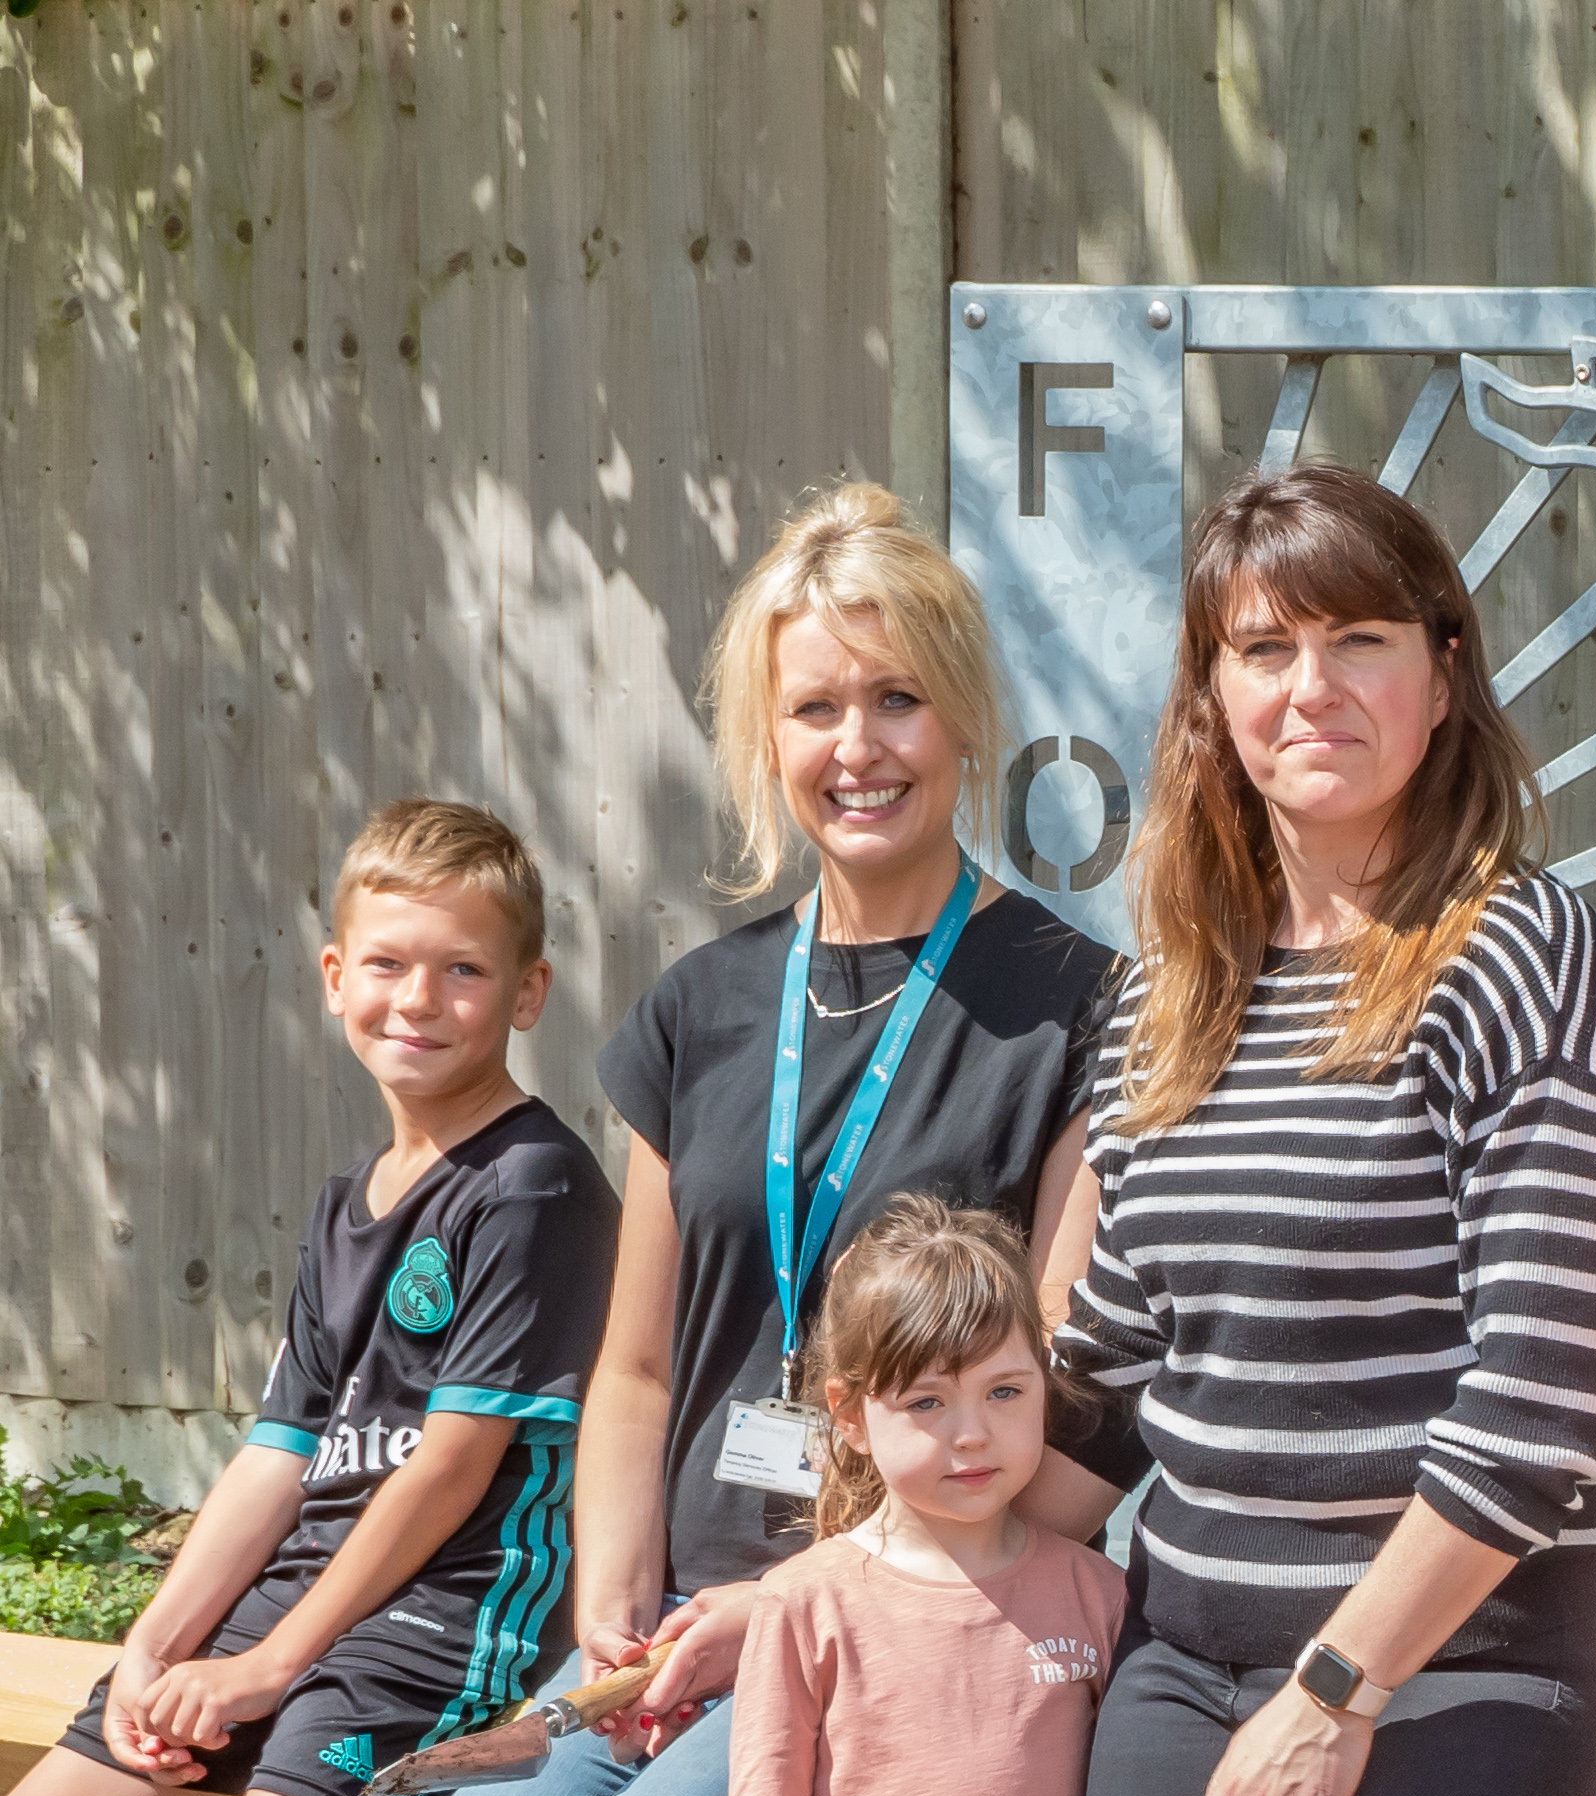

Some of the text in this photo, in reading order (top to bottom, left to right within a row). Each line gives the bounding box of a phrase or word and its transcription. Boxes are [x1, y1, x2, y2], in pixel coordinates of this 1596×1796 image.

[932, 917, 957, 966] STONEWATER
[881, 1015, 910, 1072] STONEWATER
[836, 1124, 864, 1179] STONEWATER
[1025, 1637, 1098, 1663] TODAY IS
[1029, 1662, 1098, 1685] THE DAY
